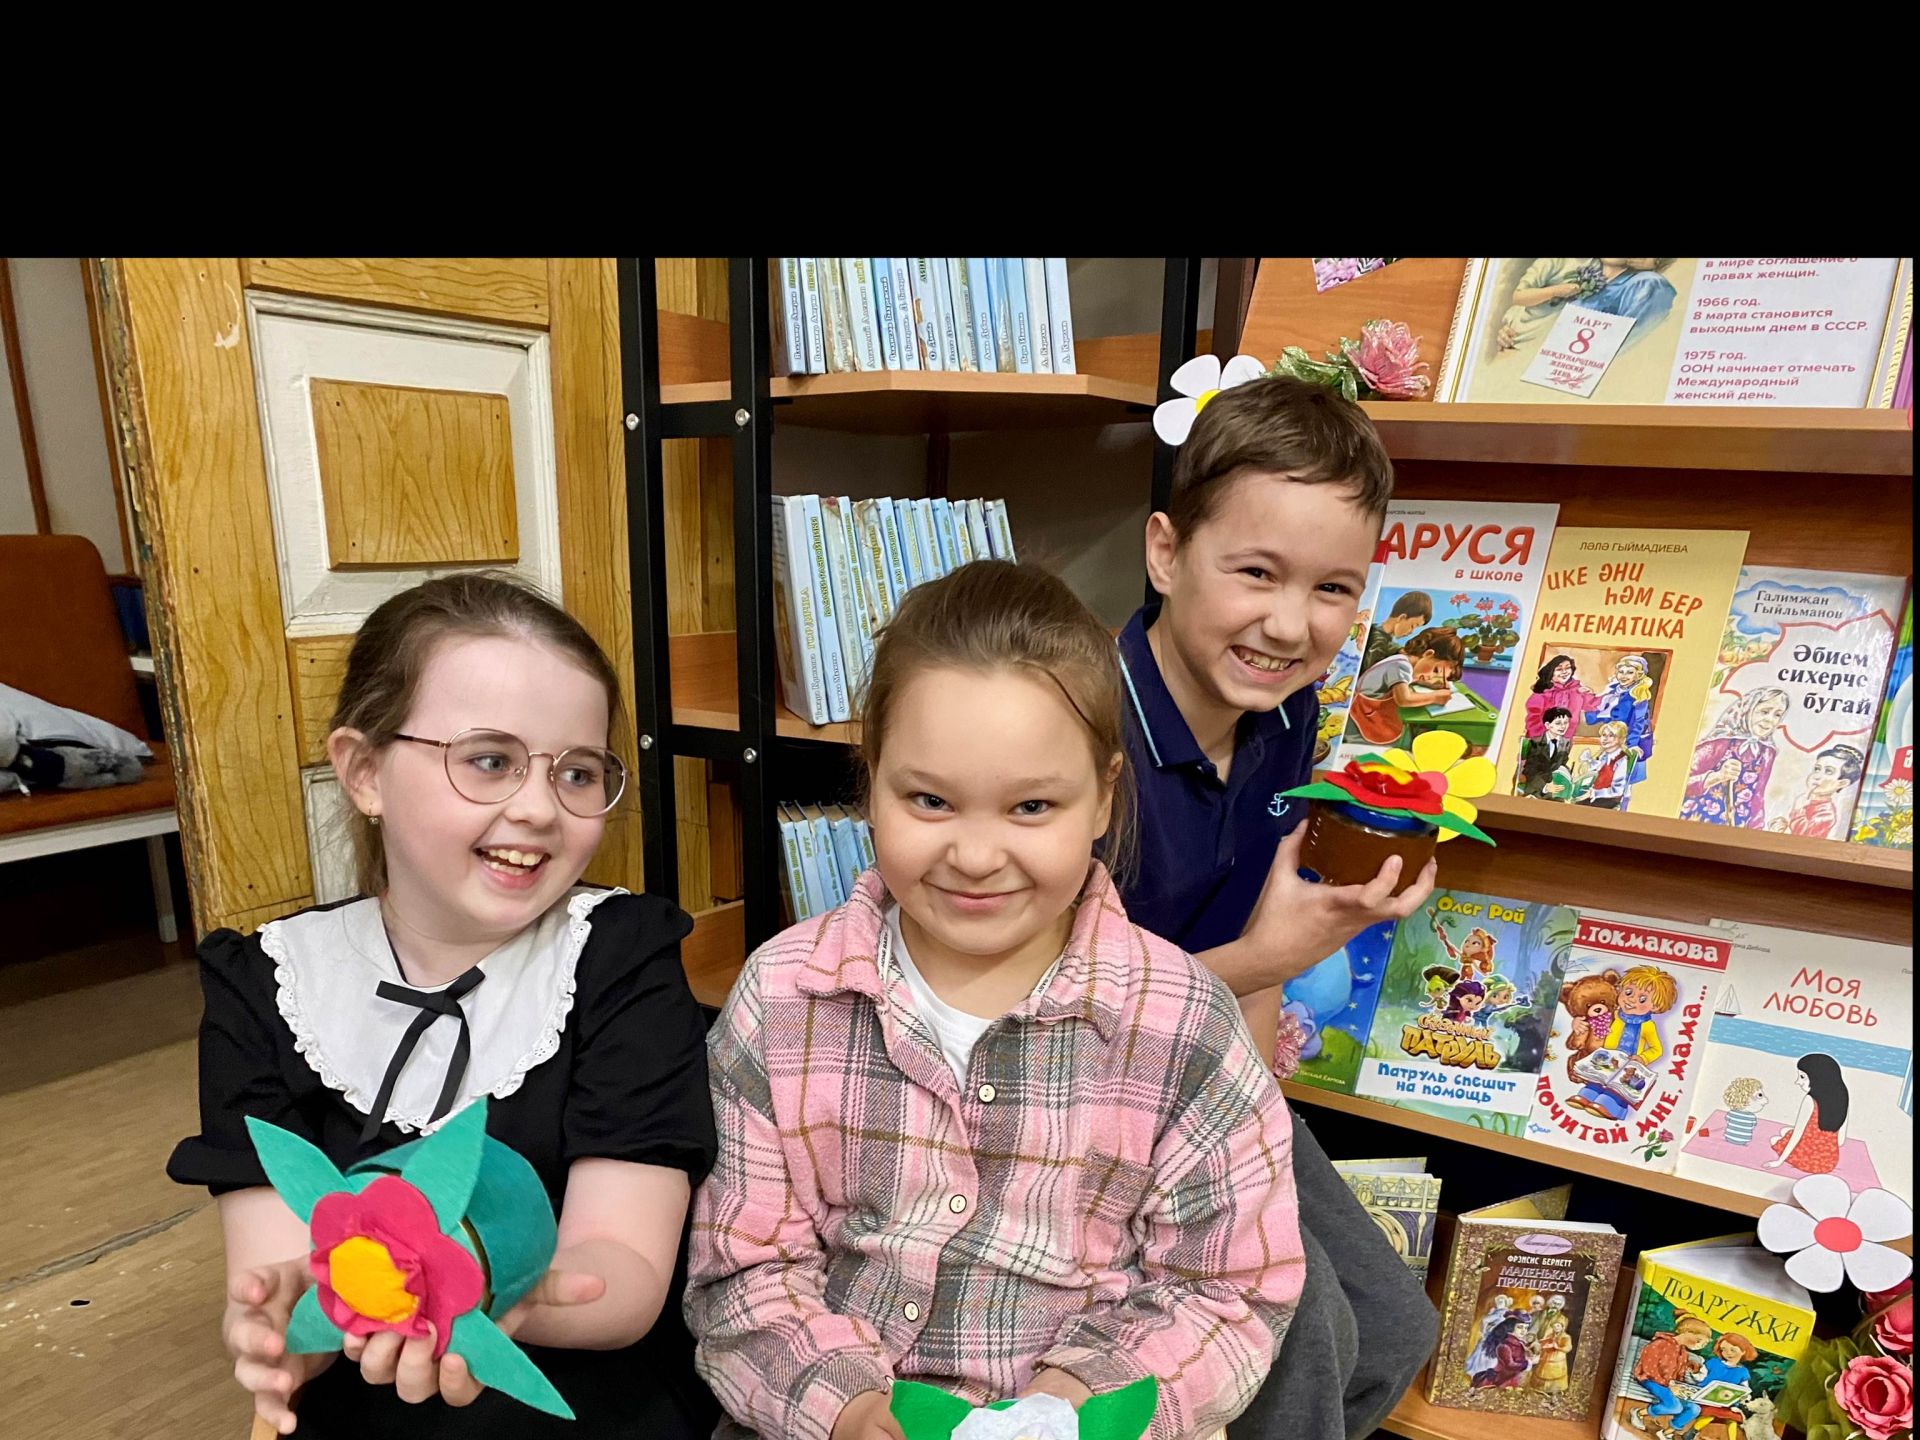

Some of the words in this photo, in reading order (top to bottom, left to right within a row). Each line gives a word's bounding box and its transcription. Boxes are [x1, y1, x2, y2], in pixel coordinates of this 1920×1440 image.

[1705, 260, 1714, 268] в
[1718, 258, 1755, 269] мире
[1757, 257, 1845, 266] соглашение
[1702, 270, 1753, 282] правах
[1756, 268, 1820, 280] женщин.
[1696, 297, 1730, 307] 1966
[1733, 298, 1761, 308] год.
[1573, 316, 1613, 330] МАРТ
[1693, 311, 1702, 320] 8
[1706, 311, 1748, 321] марта
[1751, 308, 1834, 319] становится
[1689, 324, 1766, 334] выходным
[1769, 322, 1807, 333] днем
[1811, 323, 1820, 332] в
[1824, 321, 1869, 332] СССР.
[1568, 328, 1596, 355] 8
[1683, 350, 1716, 361] 1975
[1719, 351, 1748, 361] год.
[1680, 364, 1714, 373] ООН
[1717, 364, 1784, 373] начинает
[1787, 364, 1857, 373] отмечать
[1676, 377, 1800, 388] Международный
[1673, 389, 1734, 400] женский
[1737, 391, 1777, 402] день.
[1611, 542, 1689, 554] ГЫЙМАДИЕВА
[1454, 570, 1464, 579] в
[1470, 569, 1524, 582] школе
[1546, 566, 1589, 591] ИКЕ
[1598, 562, 1645, 583] ӘНИ
[1659, 591, 1704, 617] БЕР
[1756, 589, 1830, 606] Галимжан
[1540, 612, 1685, 640] МАТЕМАТИКА
[1792, 644, 1870, 668] Әбием
[1777, 664, 1869, 691] сихерче
[1802, 692, 1873, 716] бугай
[1762, 991, 1879, 1028] ЛЮБОВЬ
[1400, 1023, 1502, 1071] ПАТРУЛЬ
[1421, 1084, 1492, 1104] помощь
[1506, 1254, 1540, 1266] ФРЭНСИС
[1541, 1256, 1574, 1268] БЕРНЕТТ
[1498, 1264, 1577, 1282] МАЛЕНЬКАЯ
[1495, 1276, 1575, 1295] ПРИНЦЕССА
[1661, 1275, 1801, 1343] ПОДРУЖКИ
